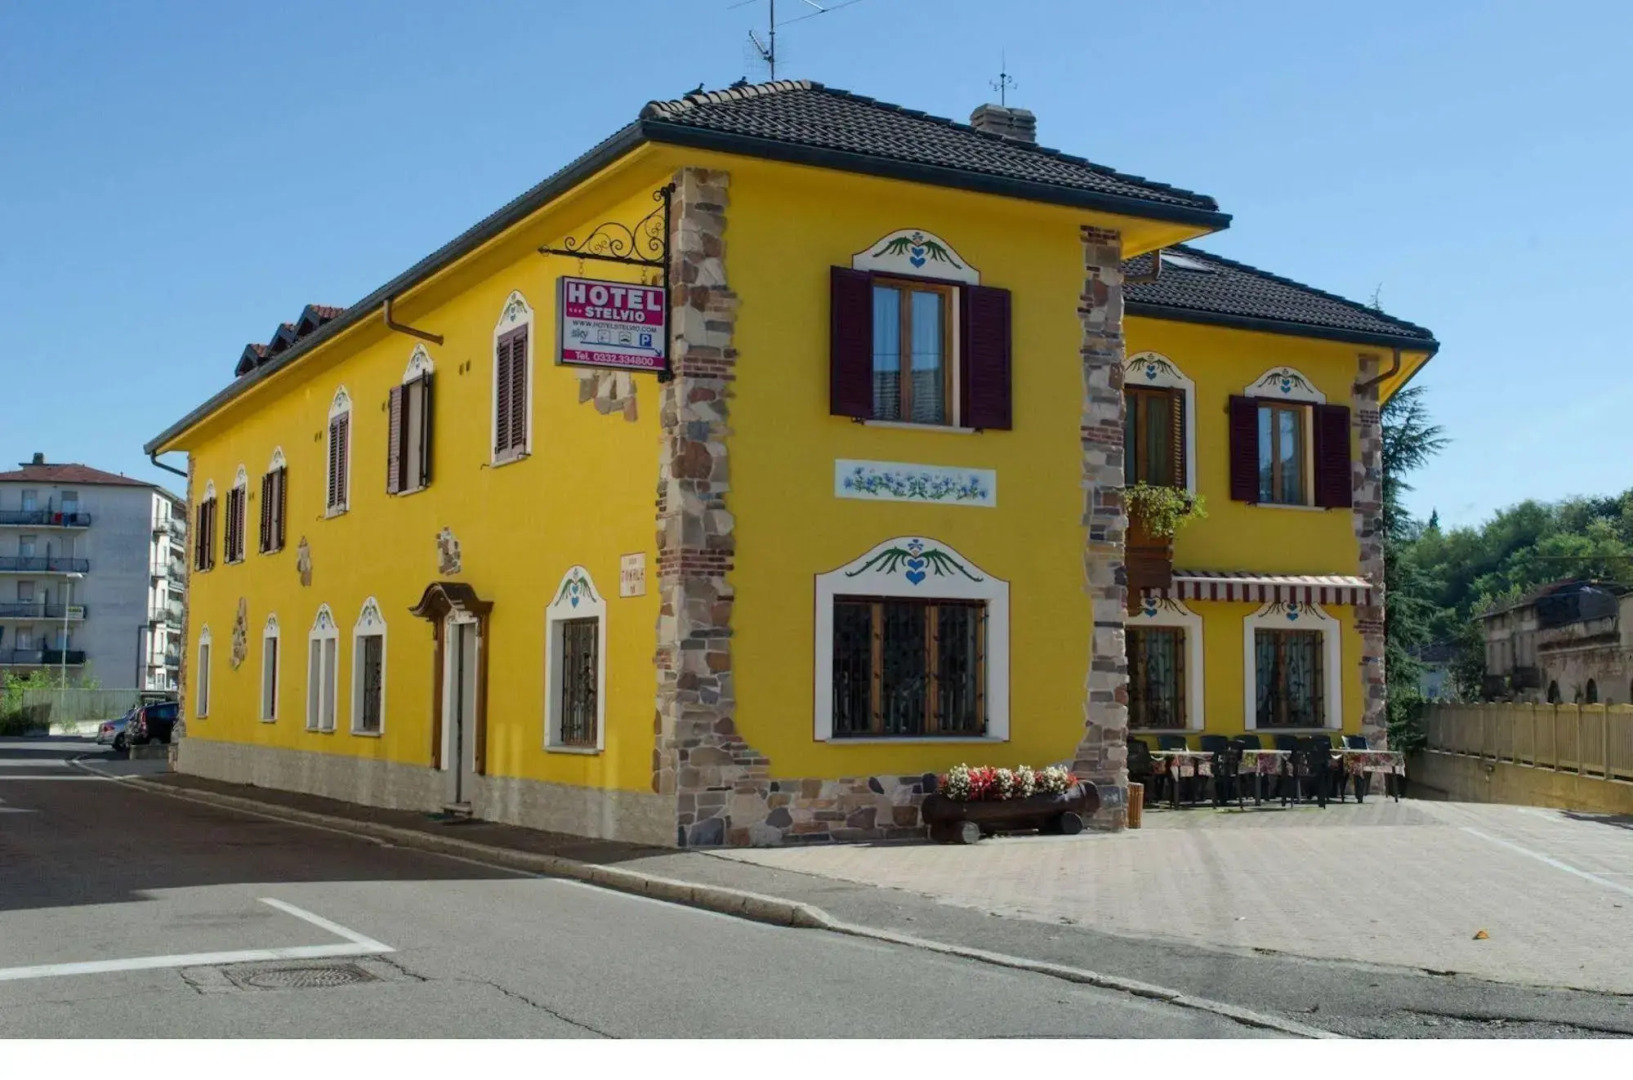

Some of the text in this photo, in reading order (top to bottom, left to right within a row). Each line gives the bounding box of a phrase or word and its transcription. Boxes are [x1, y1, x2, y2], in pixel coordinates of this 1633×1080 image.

[568, 283, 661, 311] HOTEL
[585, 306, 645, 322] STELVIO
[641, 335, 651, 345] P
[575, 351, 590, 360] Tel.
